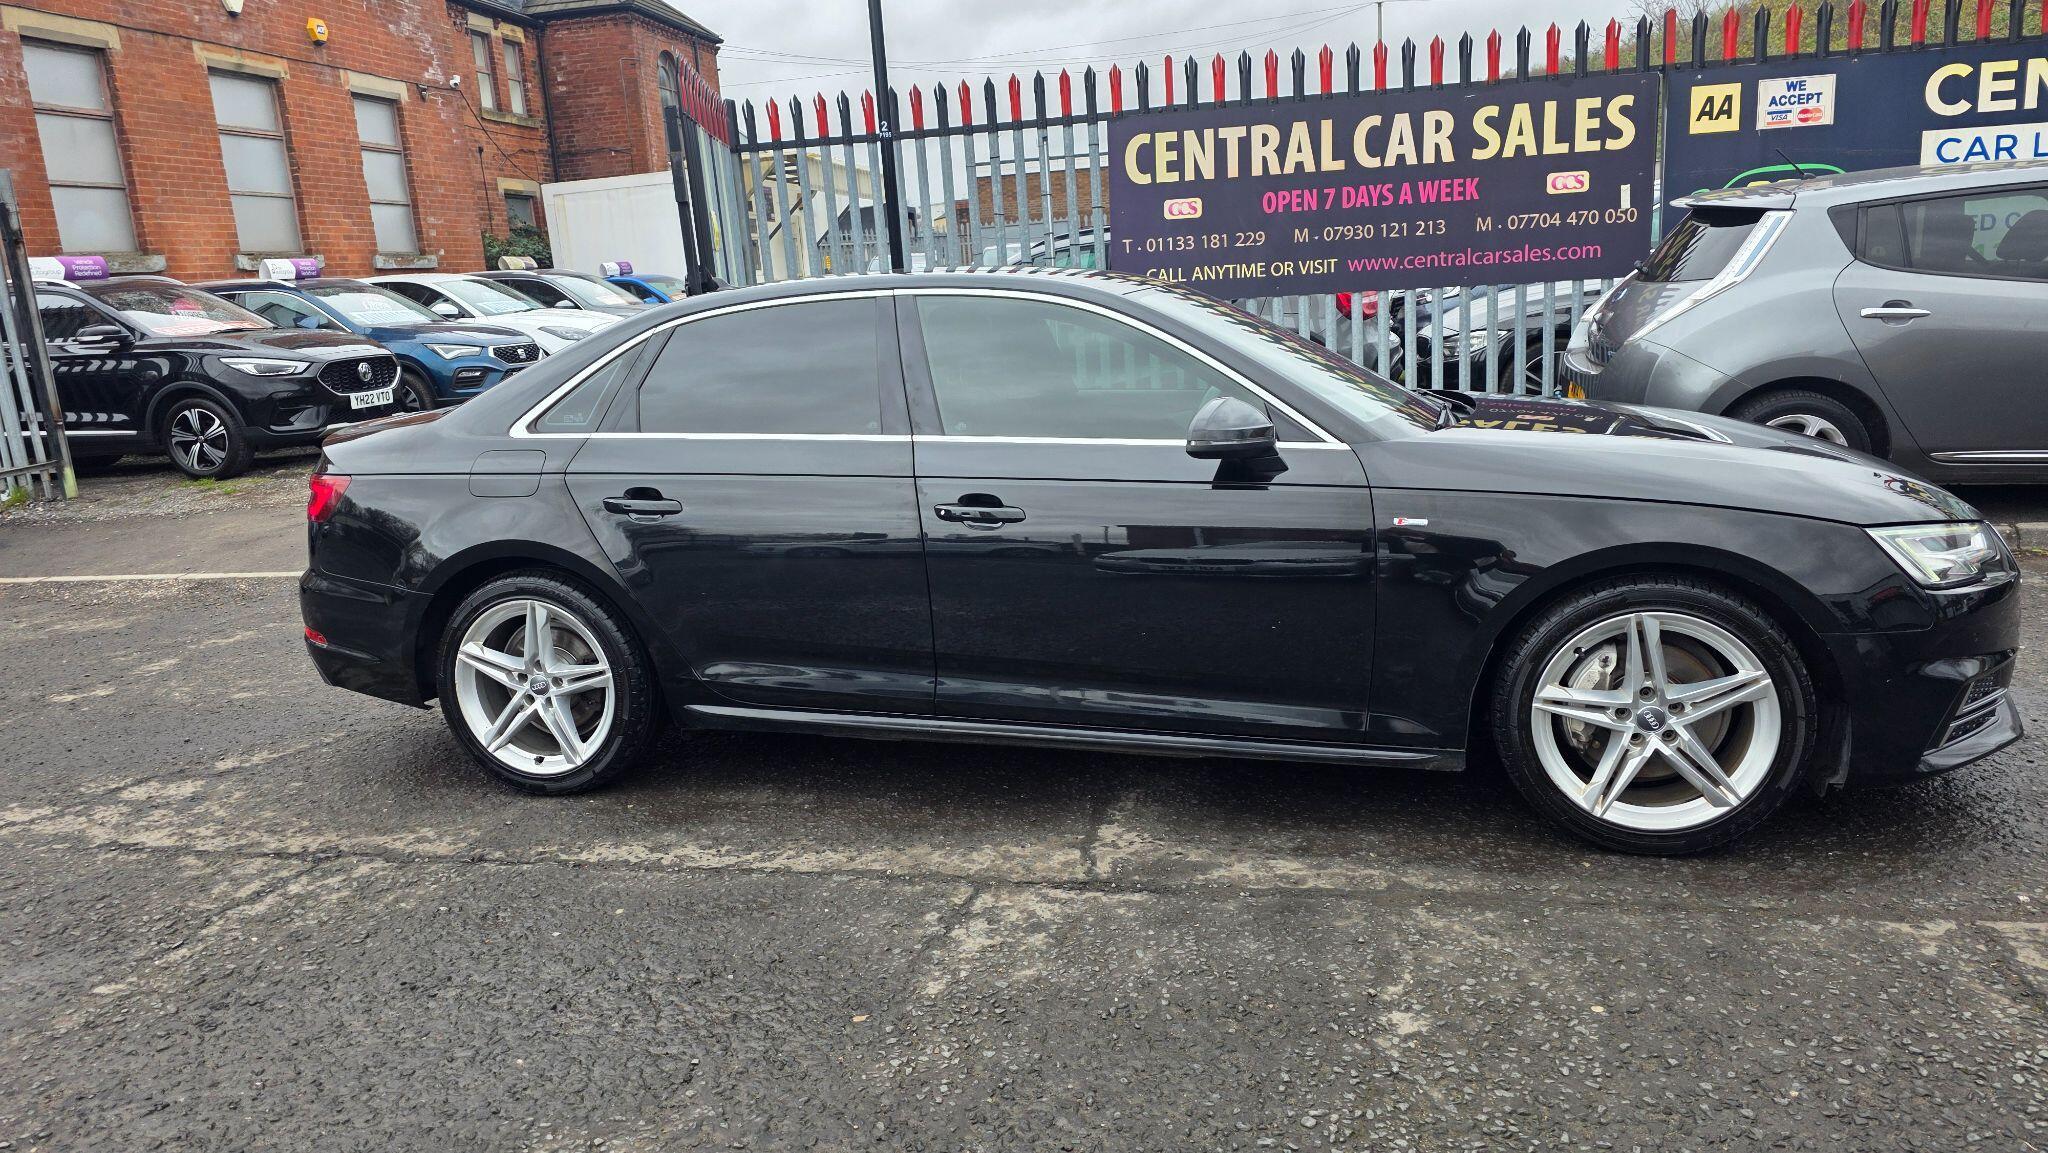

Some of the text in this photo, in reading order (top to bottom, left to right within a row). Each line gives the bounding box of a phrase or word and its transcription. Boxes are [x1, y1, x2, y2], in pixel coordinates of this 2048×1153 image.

[1785, 80, 1807, 92] WE
[1695, 94, 1733, 121] AA
[1768, 92, 1823, 107] ACCEPT
[881, 121, 889, 131] 2
[1125, 94, 1636, 185] CENTRAL CAR SALES
[1936, 134, 2019, 163] CAR
[1262, 177, 1480, 214] OPEN 7 DAYS A WEEK
[1507, 212, 1561, 230] 07704
[1567, 210, 1599, 227] 470
[1604, 207, 1638, 224] 050
[1323, 224, 1374, 241] 07930
[1380, 222, 1407, 238] 121
[1415, 219, 1446, 236] 213
[1146, 235, 1195, 252] 01133
[1201, 233, 1228, 249] 181
[1234, 231, 1266, 247] 229
[1146, 244, 1601, 283] CALL ANYTIME OR VISIT www.centralcarsales.com
[354, 391, 391, 406] YH22 VTO
